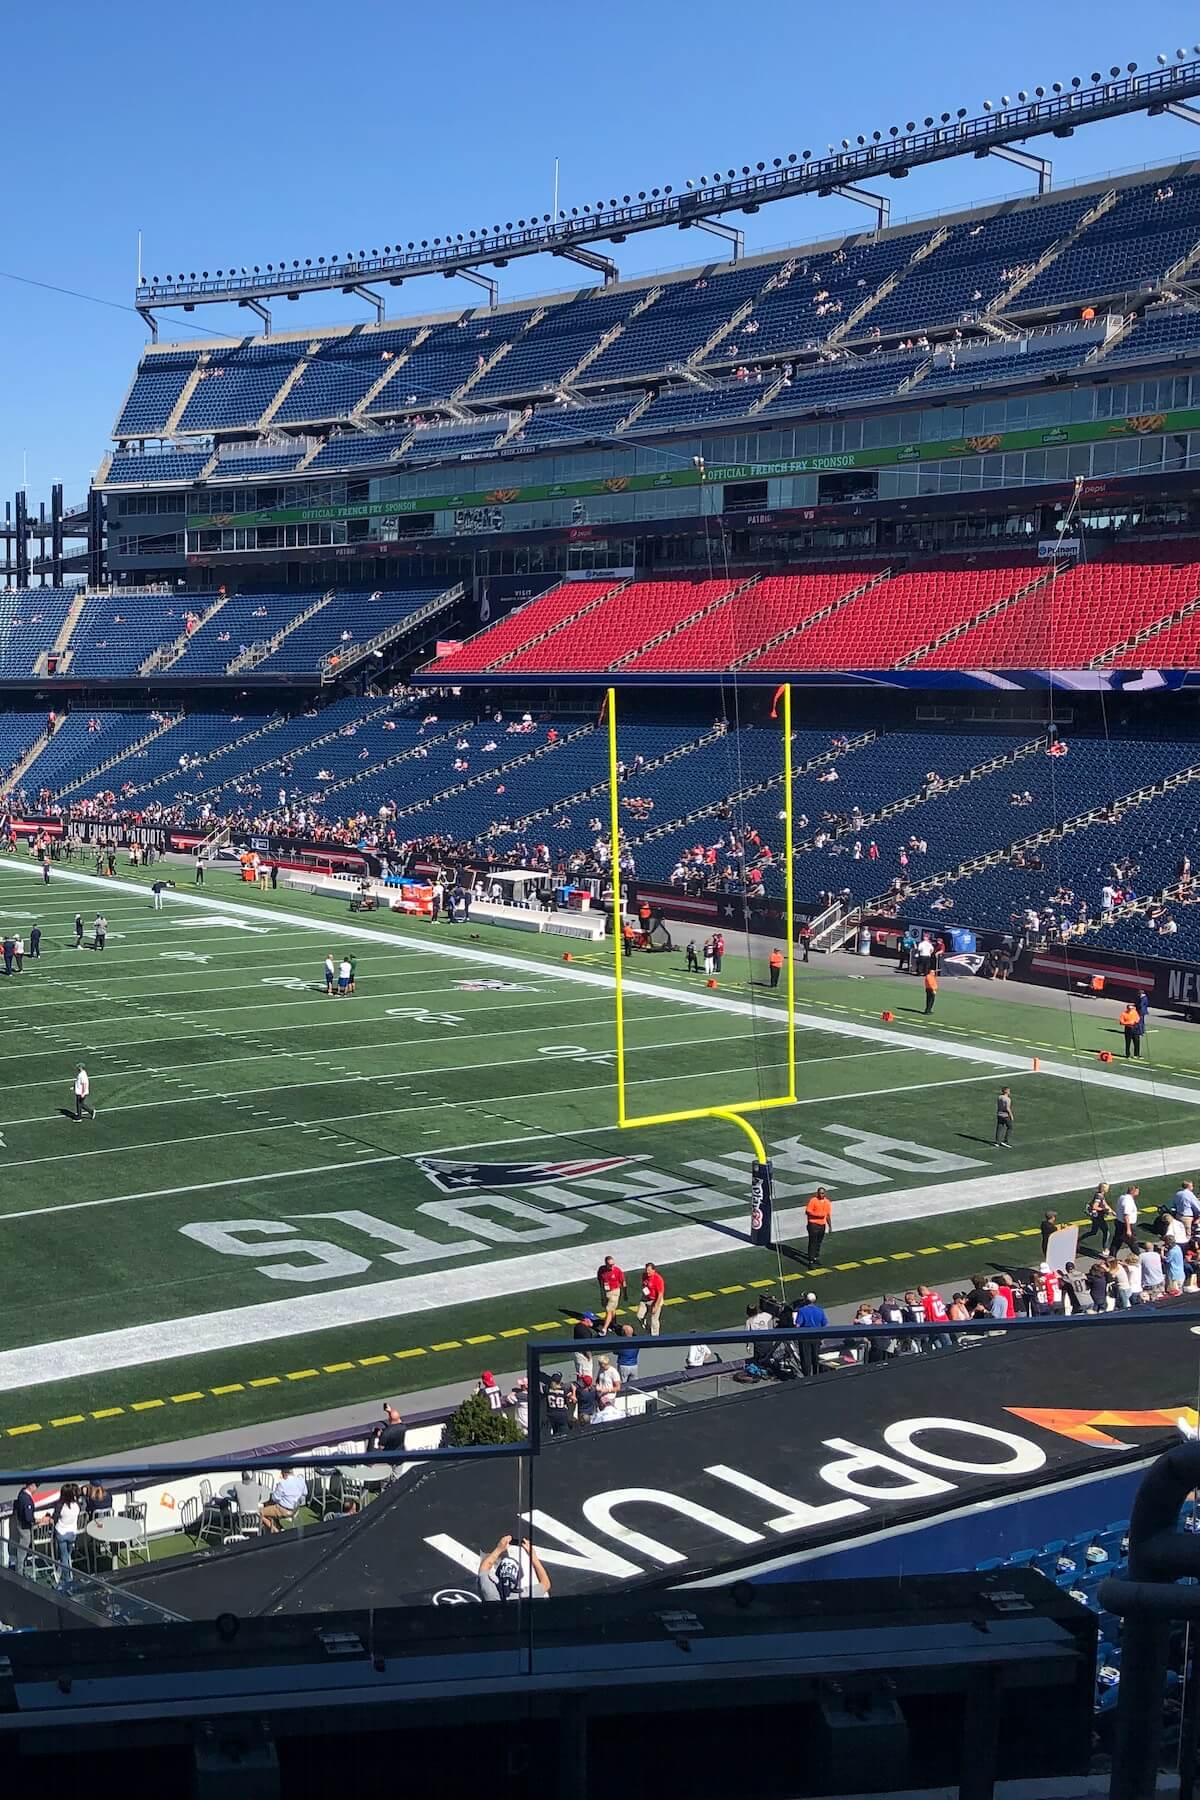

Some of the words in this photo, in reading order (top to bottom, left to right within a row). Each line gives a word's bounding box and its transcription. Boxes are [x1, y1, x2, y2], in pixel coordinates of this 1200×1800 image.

[708, 467, 746, 480] OFFICIAL
[751, 463, 788, 476] FRENCH
[790, 460, 808, 472] FRY
[812, 455, 855, 469] SPONSOR
[302, 510, 334, 519] OFFICIAL
[338, 506, 367, 516] FRENCH
[369, 504, 382, 512] FRY
[385, 501, 417, 511] SPONSOR
[68, 821, 86, 837] NEW
[126, 826, 166, 845] PATRIOTS
[385, 1007, 466, 1027] 20
[537, 1045, 617, 1065] 10
[180, 1124, 993, 1284] PATRIOTS
[932, 1300, 946, 1316] 12
[490, 1392, 501, 1408] 11
[548, 1395, 565, 1408] 60
[422, 1417, 1048, 1580] OPTUM
